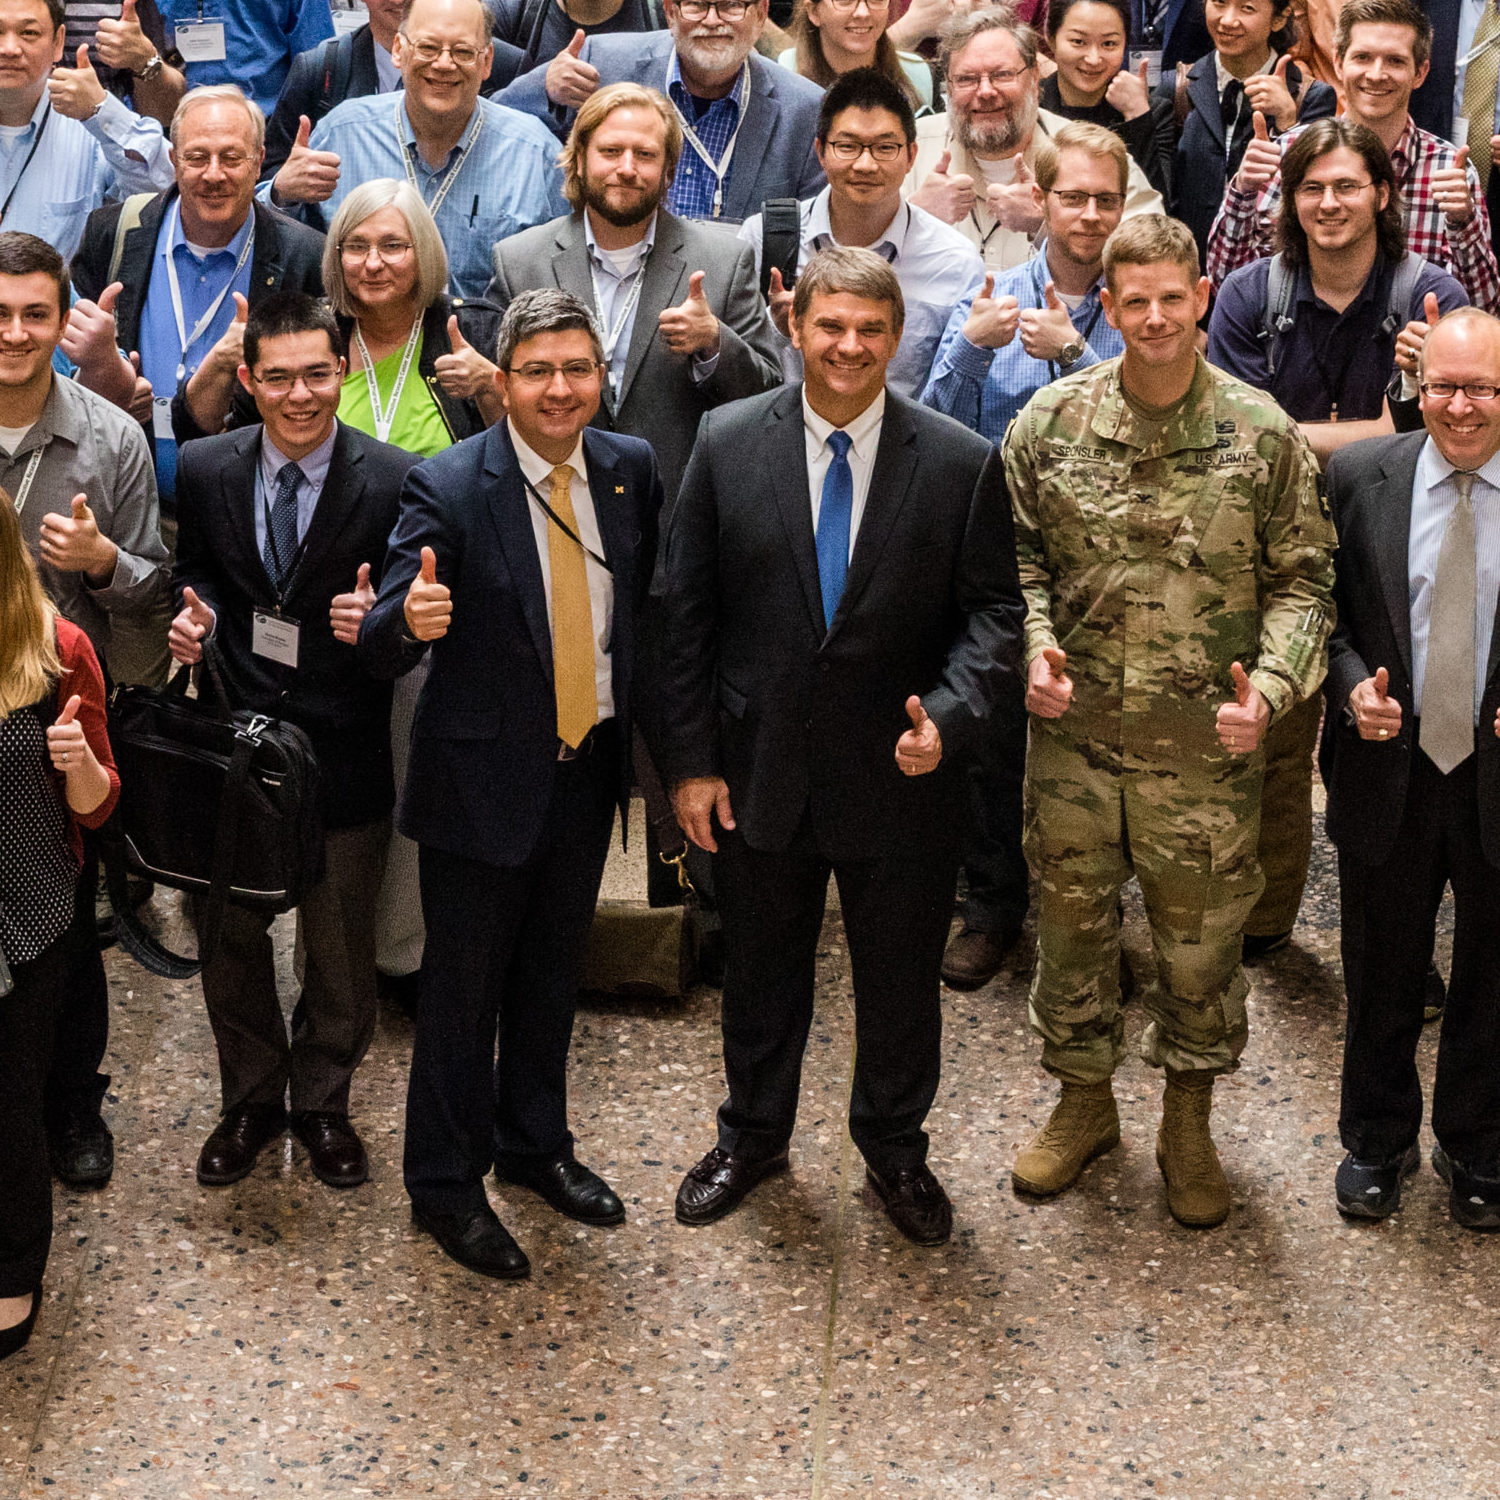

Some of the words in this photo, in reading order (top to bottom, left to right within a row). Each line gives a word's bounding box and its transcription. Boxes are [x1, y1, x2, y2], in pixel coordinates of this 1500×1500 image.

[1058, 445, 1106, 460] SPONSLER
[1195, 454, 1215, 465] U.S.
[1217, 452, 1249, 465] ARMY
